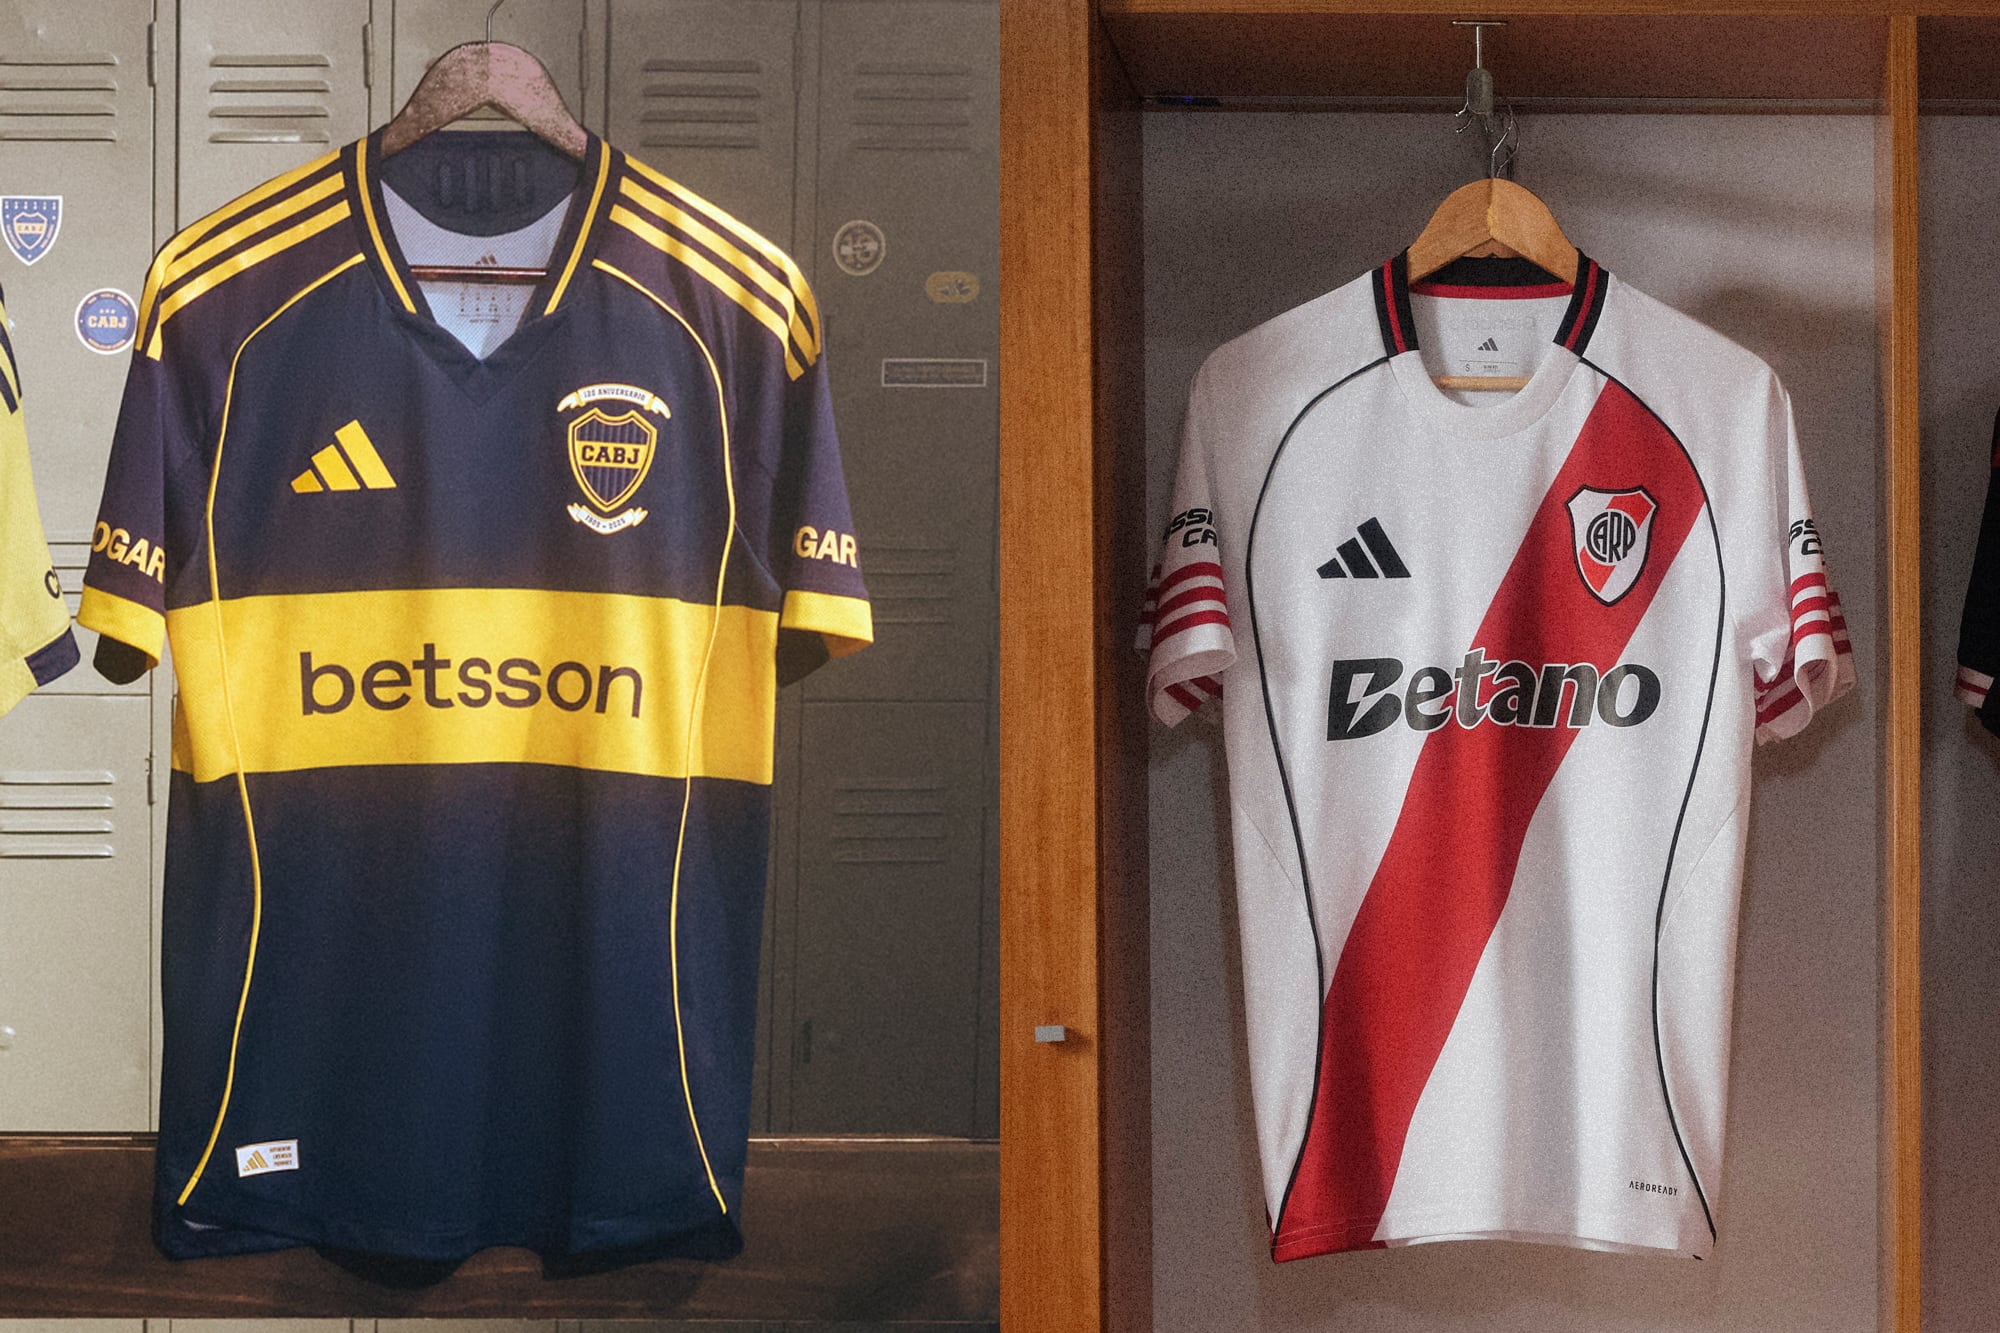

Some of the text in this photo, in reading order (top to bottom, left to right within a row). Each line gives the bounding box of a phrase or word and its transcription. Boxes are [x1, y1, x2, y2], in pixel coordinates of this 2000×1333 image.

[88, 315, 128, 329] CABJ
[581, 445, 641, 465] CABJ
[793, 525, 858, 569] GAR
[300, 643, 643, 718] betsson
[1327, 648, 1662, 741] Betano
[1628, 1180, 1678, 1196] AEROREADY
